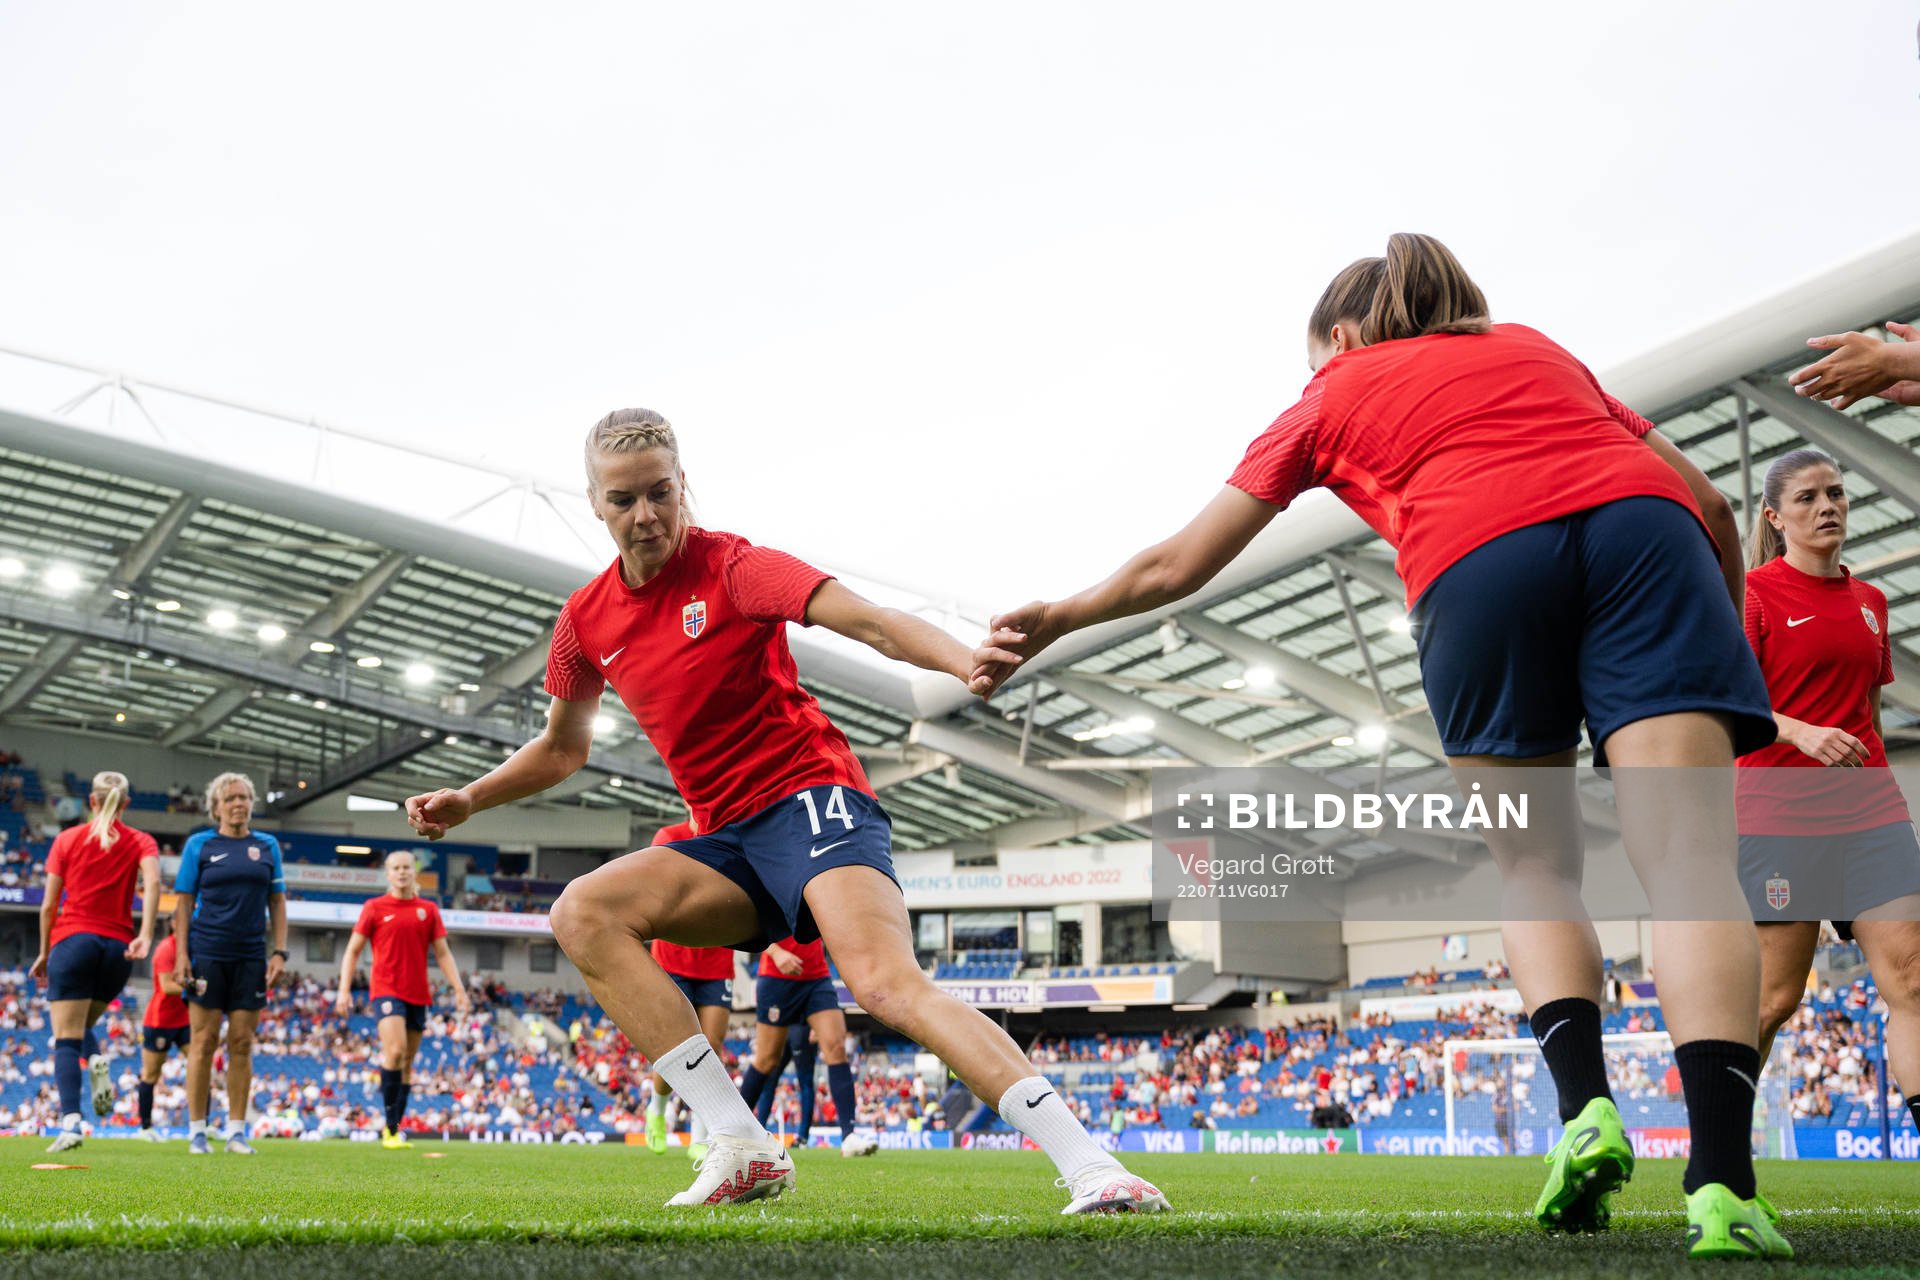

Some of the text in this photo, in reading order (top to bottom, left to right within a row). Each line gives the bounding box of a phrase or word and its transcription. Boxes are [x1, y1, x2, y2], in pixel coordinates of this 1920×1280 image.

[797, 785, 855, 836] 14
[902, 870, 1121, 890] MEN'S EURO ENGLAND 2022
[946, 986, 975, 1003] ON
[979, 986, 993, 1002] &
[1142, 1131, 1185, 1153] VISA
[1214, 1130, 1319, 1154] Heineken
